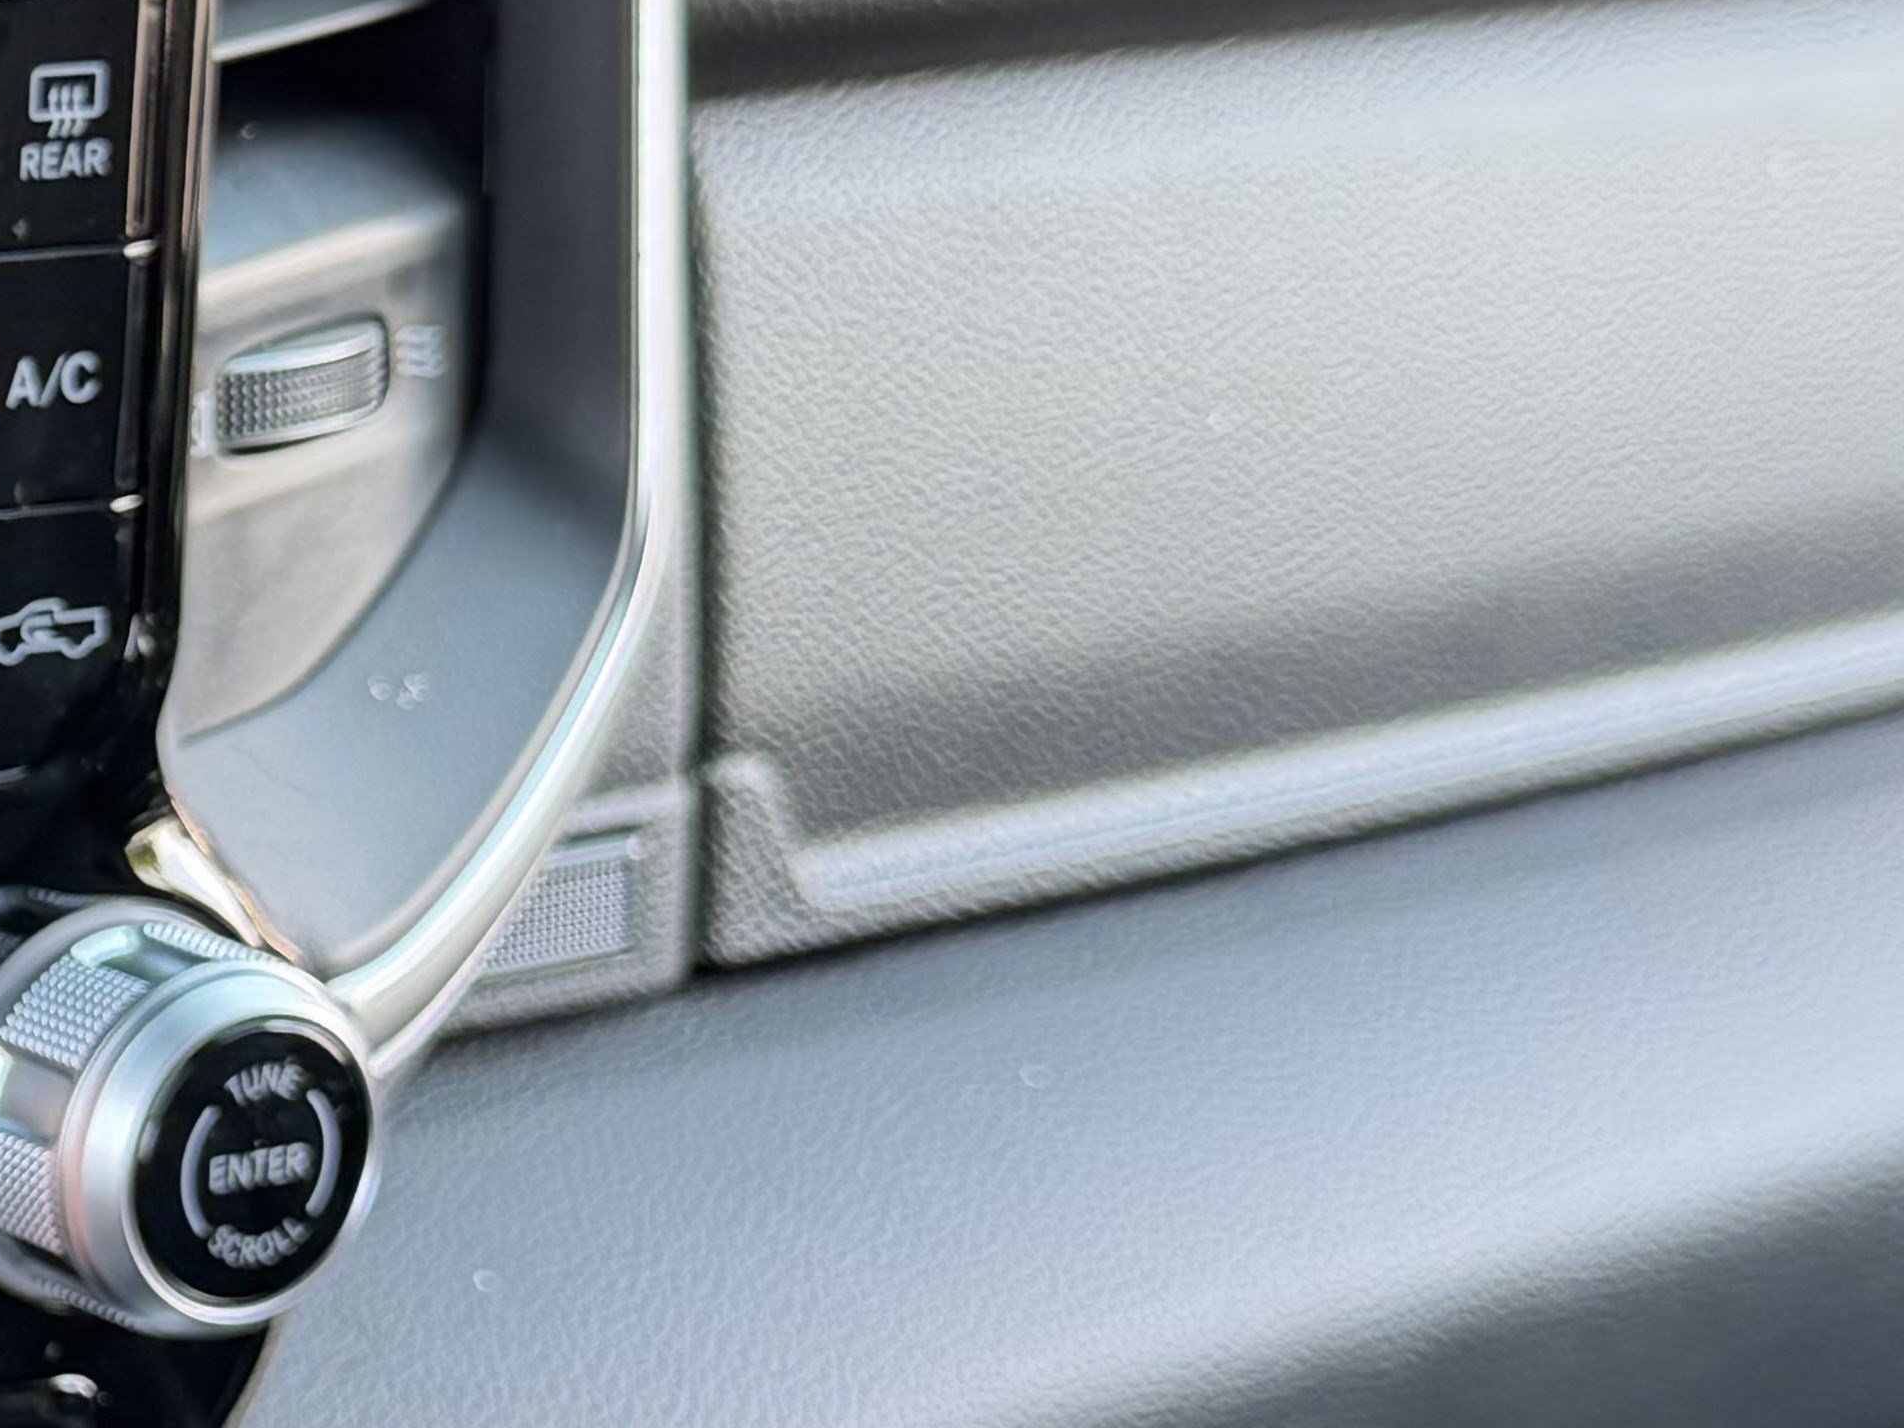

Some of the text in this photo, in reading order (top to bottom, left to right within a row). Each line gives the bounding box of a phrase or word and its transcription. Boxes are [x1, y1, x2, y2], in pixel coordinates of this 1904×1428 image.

[20, 138, 112, 181] REAR
[5, 351, 101, 410] A/C
[224, 1064, 304, 1108] TUNE
[208, 1142, 313, 1195] ENTER
